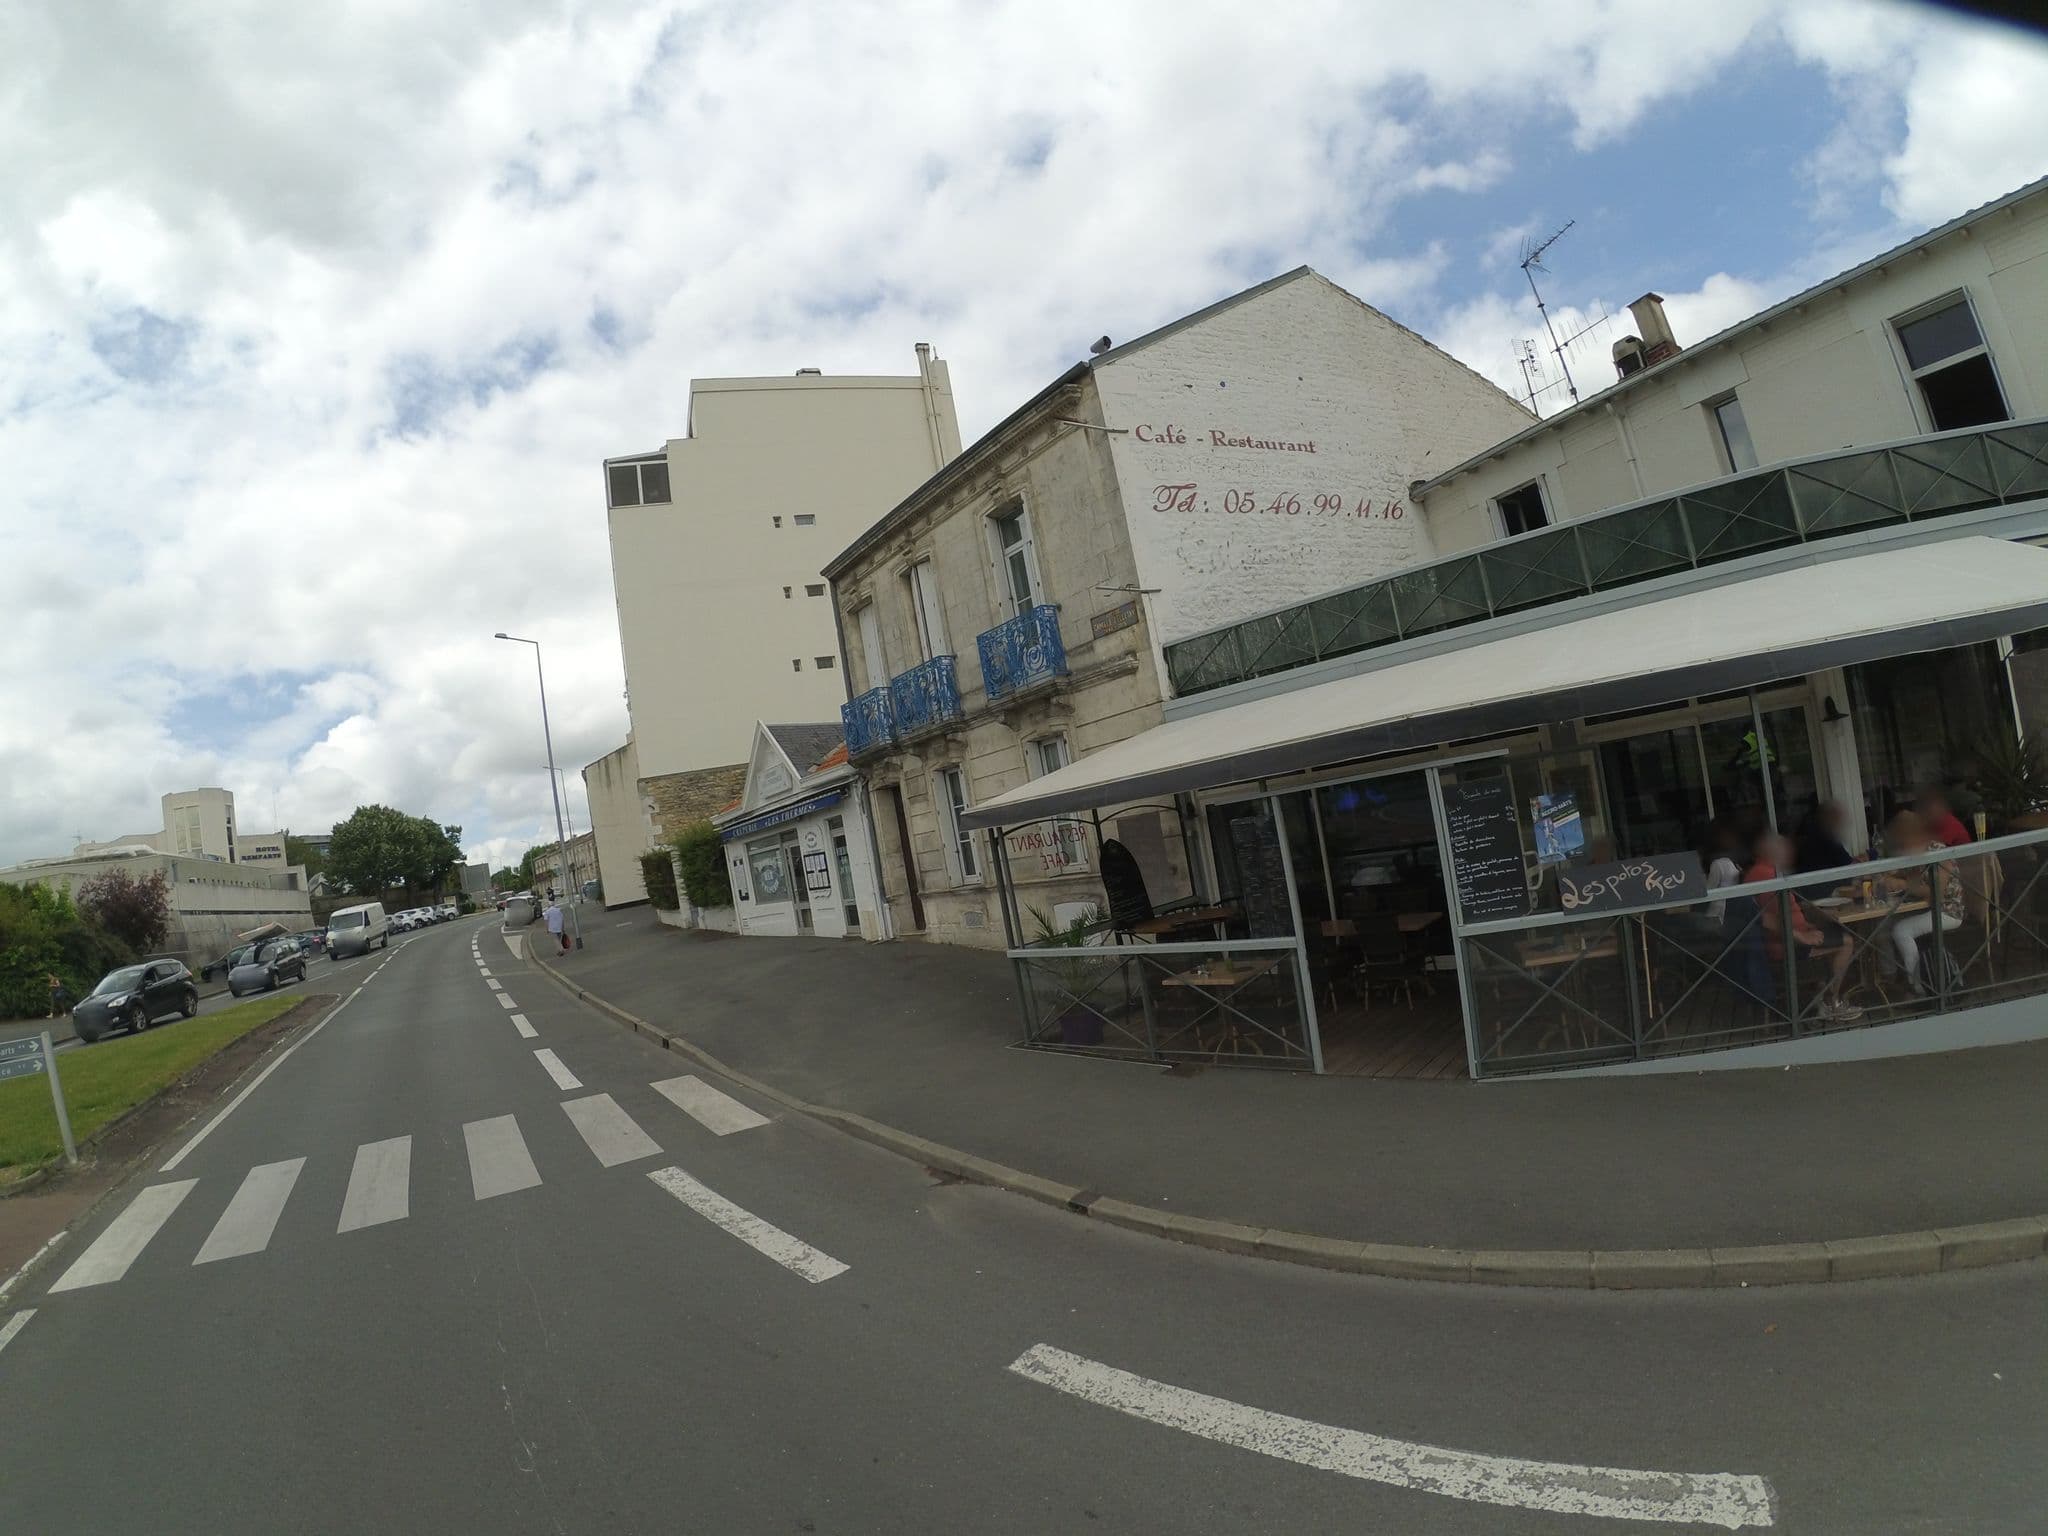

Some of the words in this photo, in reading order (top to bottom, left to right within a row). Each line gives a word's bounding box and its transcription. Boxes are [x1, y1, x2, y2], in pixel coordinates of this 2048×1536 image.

[1135, 424, 1187, 444] Café
[1209, 428, 1318, 453] Restaurant
[1224, 489, 1405, 520] 05.46.99.11.16
[241, 853, 282, 861] REMPARTS
[1561, 877, 1606, 908] Les
[1605, 861, 1654, 901] potos
[0, 1047, 15, 1056] arts
